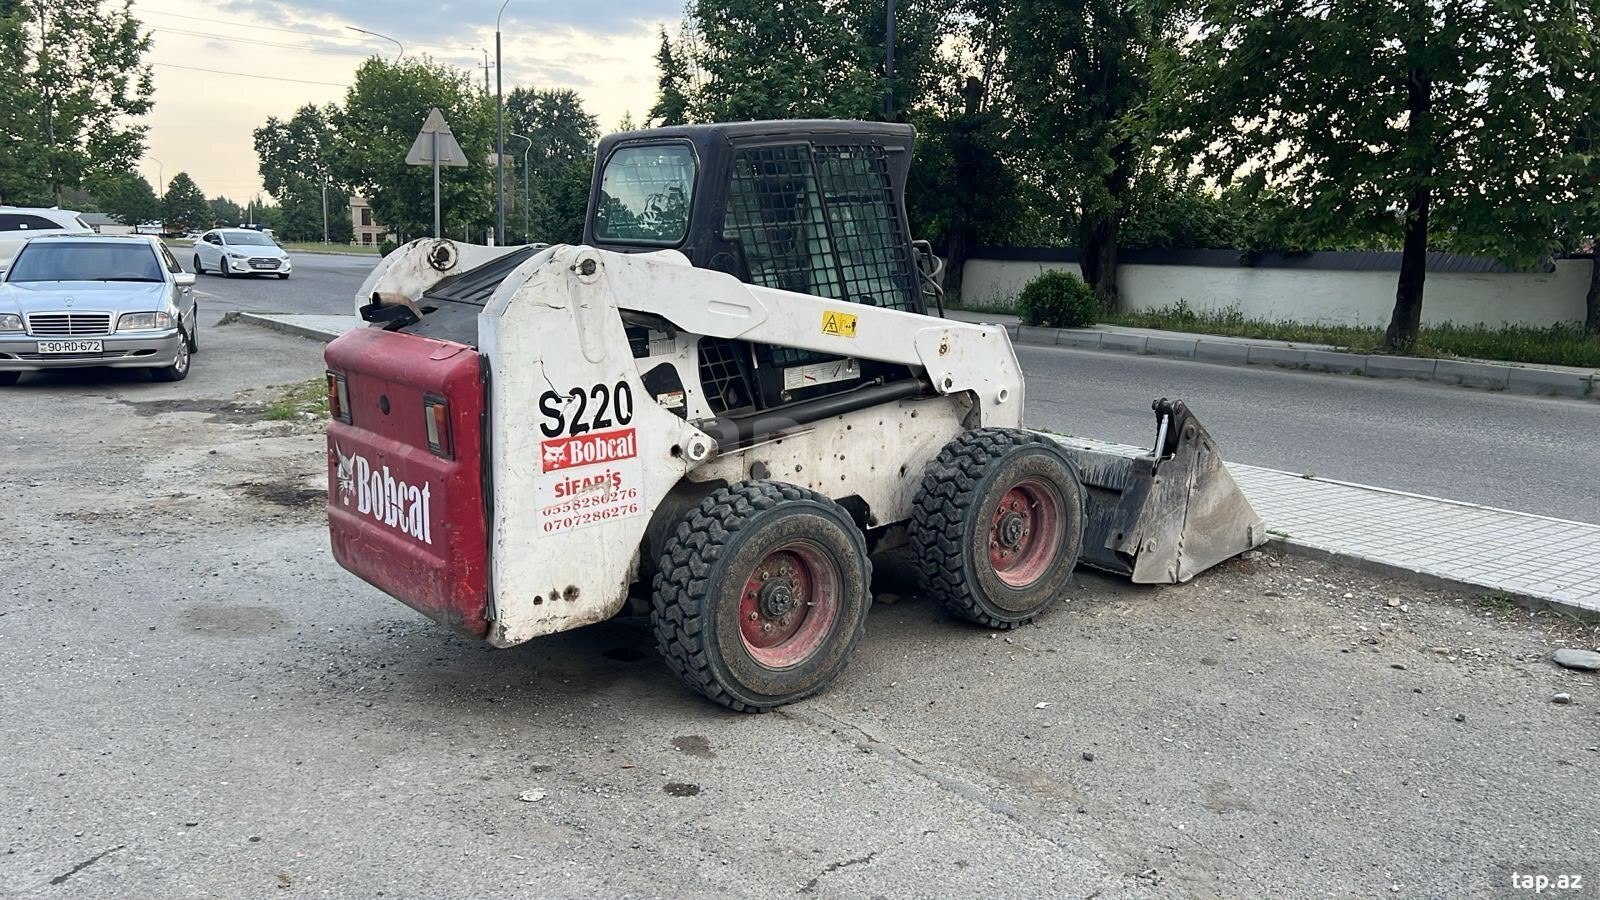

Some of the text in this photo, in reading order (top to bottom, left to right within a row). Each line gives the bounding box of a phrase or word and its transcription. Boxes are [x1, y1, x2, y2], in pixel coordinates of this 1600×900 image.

[48, 342, 100, 351] 90-RD-672
[539, 381, 633, 437] S220
[569, 433, 634, 462] Bobcat
[356, 455, 431, 544] Bobcat
[543, 503, 638, 532] 0707286276
